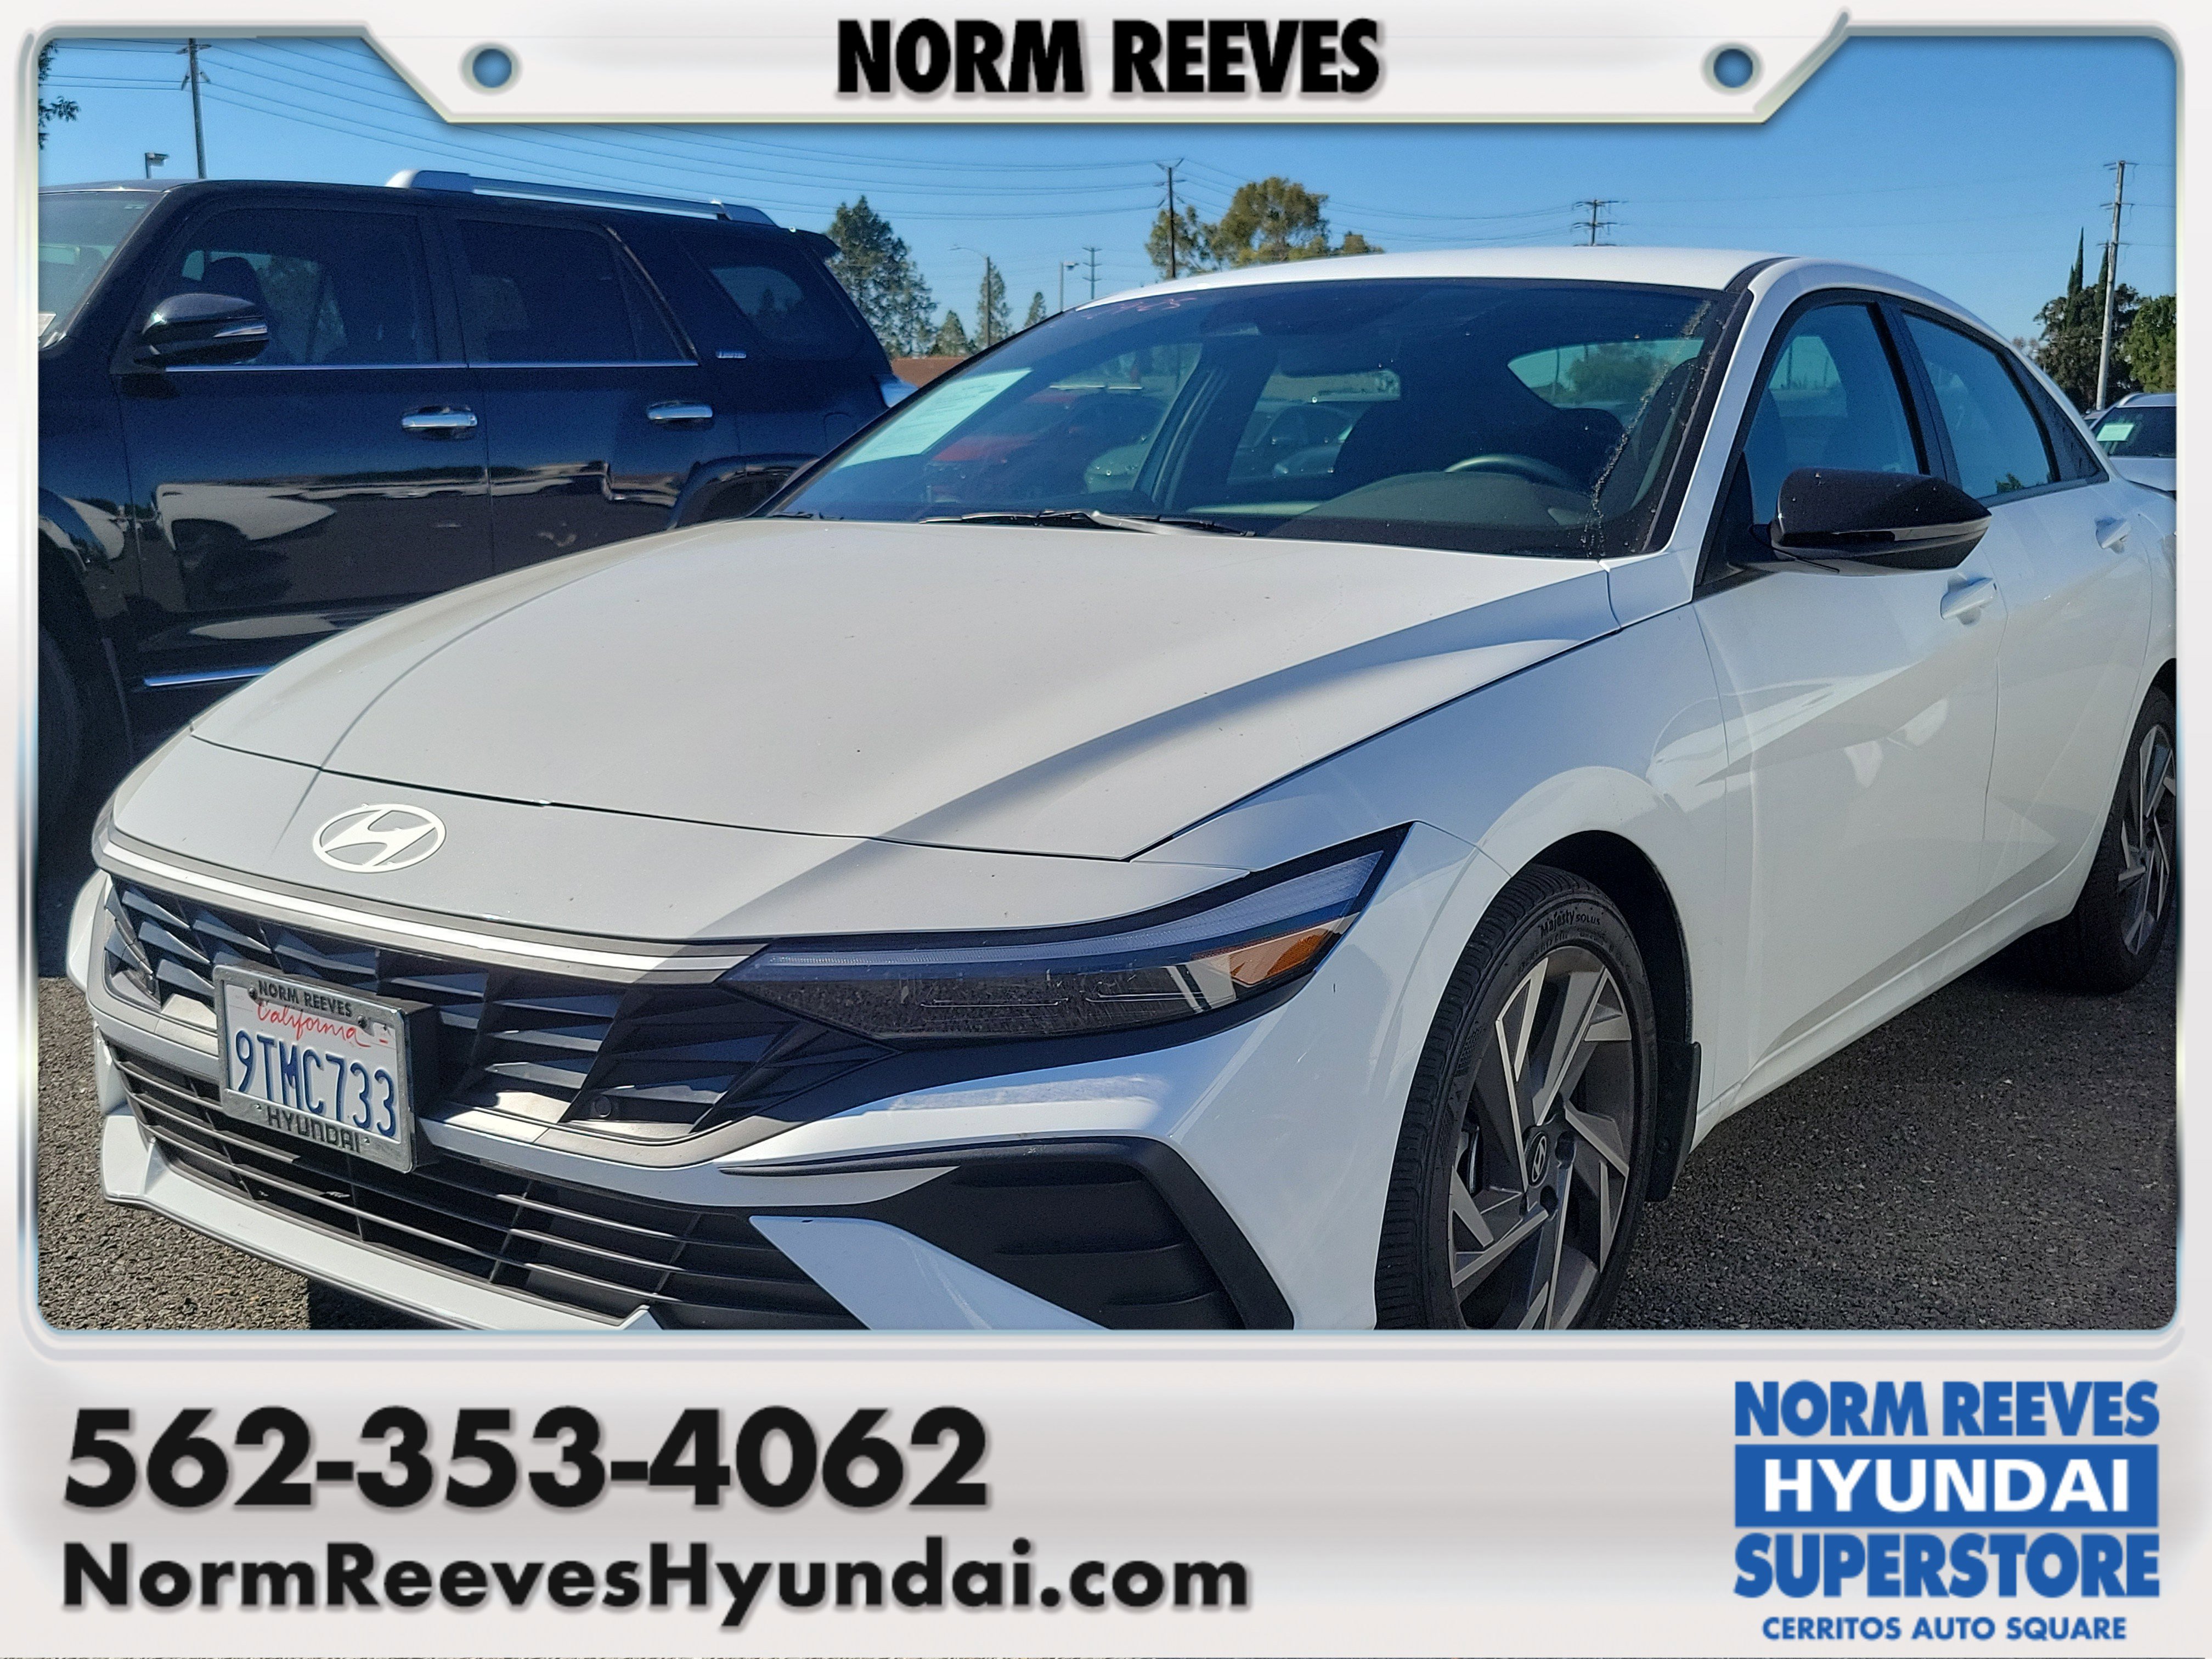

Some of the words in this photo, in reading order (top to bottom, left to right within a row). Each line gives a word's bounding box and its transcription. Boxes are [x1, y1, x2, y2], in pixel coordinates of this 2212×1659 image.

[258, 979, 299, 1004] NORM
[304, 988, 353, 1017] REEVES
[256, 1002, 371, 1048] California
[235, 1029, 396, 1138] 9TMC733
[267, 1105, 362, 1153] HYUNDAI
